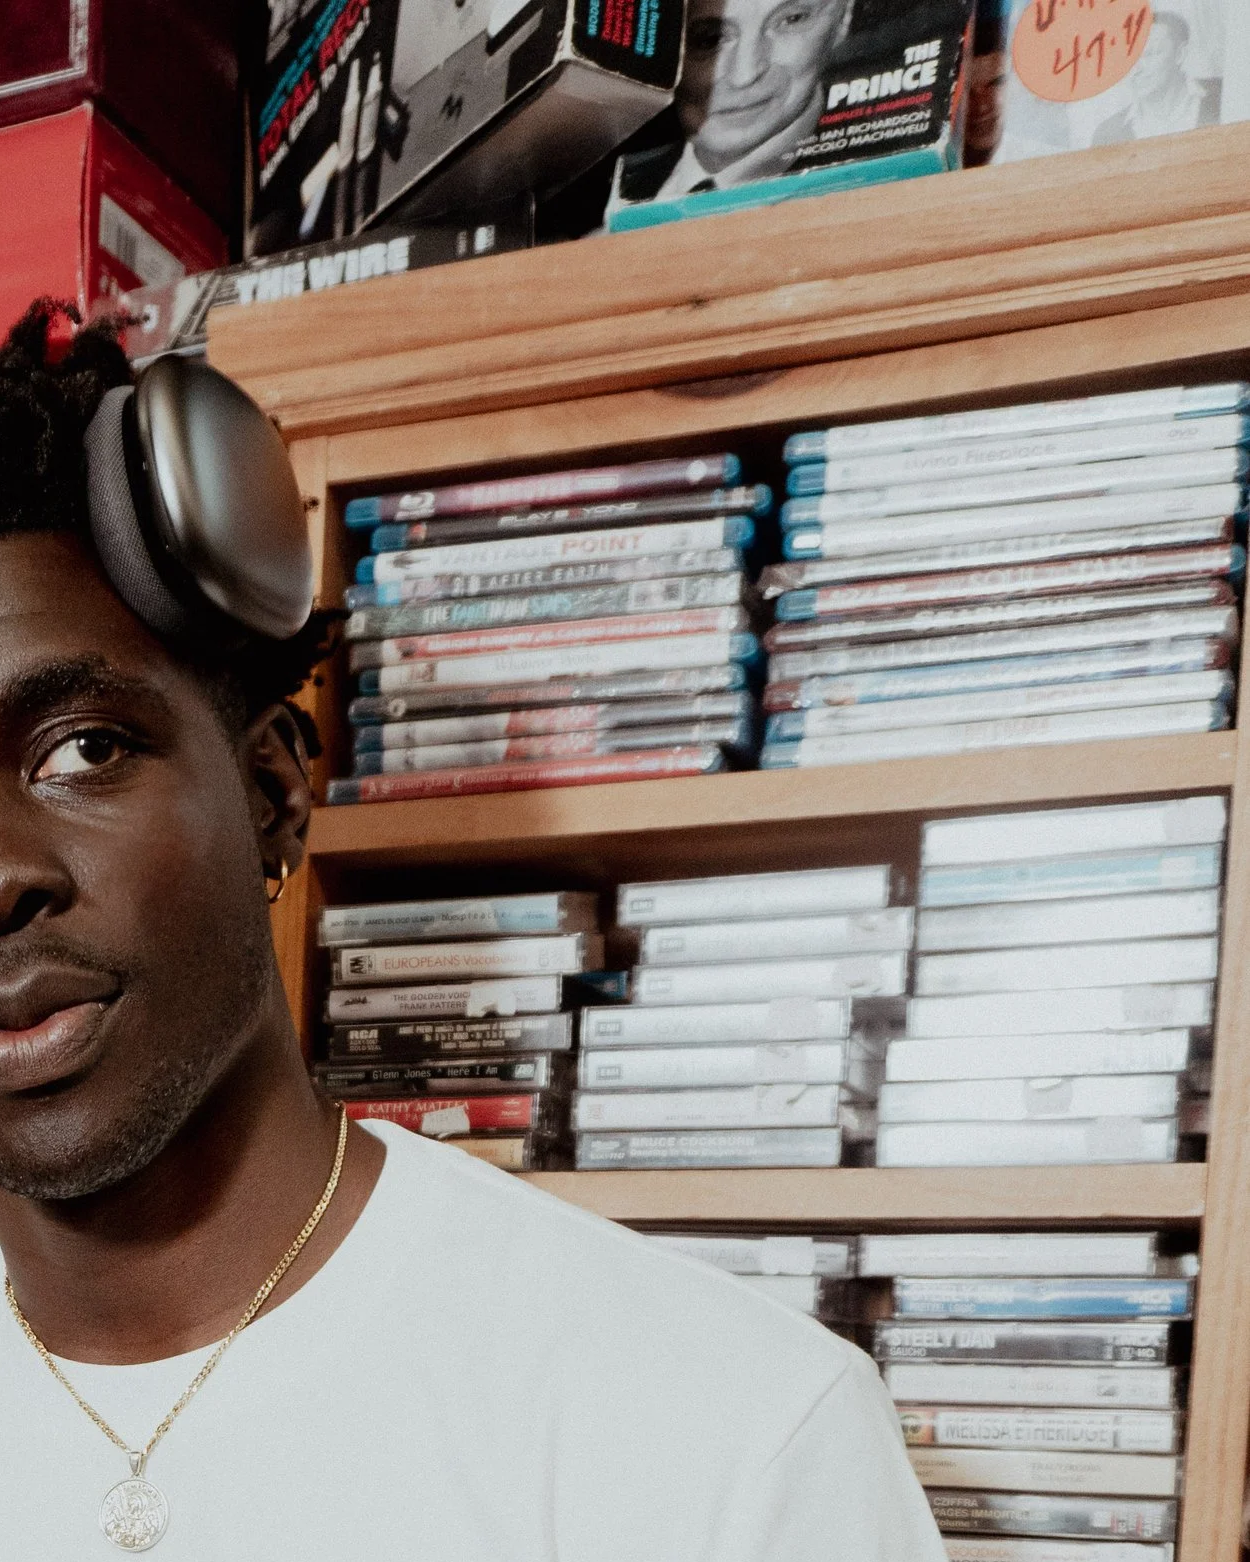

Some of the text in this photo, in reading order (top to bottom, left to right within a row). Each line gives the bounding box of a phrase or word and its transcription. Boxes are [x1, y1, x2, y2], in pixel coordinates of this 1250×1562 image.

[904, 39, 942, 64] THE
[827, 60, 940, 110] PRINCE
[818, 109, 932, 141] IAN RICHARDSON
[848, 121, 930, 146] MACHIAVELLI
[237, 236, 413, 304] THE WIRE
[964, 441, 1058, 466] Fireplace
[561, 533, 645, 556] POINT
[487, 562, 611, 590] AFTER EARTH
[421, 605, 451, 628] THE
[384, 955, 461, 970] EUROPEANS
[400, 1001, 428, 1011] FRANK
[348, 1029, 380, 1041] RCA
[372, 1070, 400, 1080] Glenn
[404, 1068, 431, 1079] Jones
[447, 1066, 471, 1077] Here
[485, 1065, 498, 1075] Am
[368, 1102, 410, 1114] KATHY
[630, 1134, 756, 1148] BRUCE COCKBURN
[889, 1327, 996, 1348] STEELY DAN
[889, 1348, 927, 1358] GAUCHO
[945, 1418, 1110, 1444] MELISSA ETHERIDGE
[933, 1498, 979, 1509] CZIFFRA
[933, 1508, 970, 1519] PAGES
